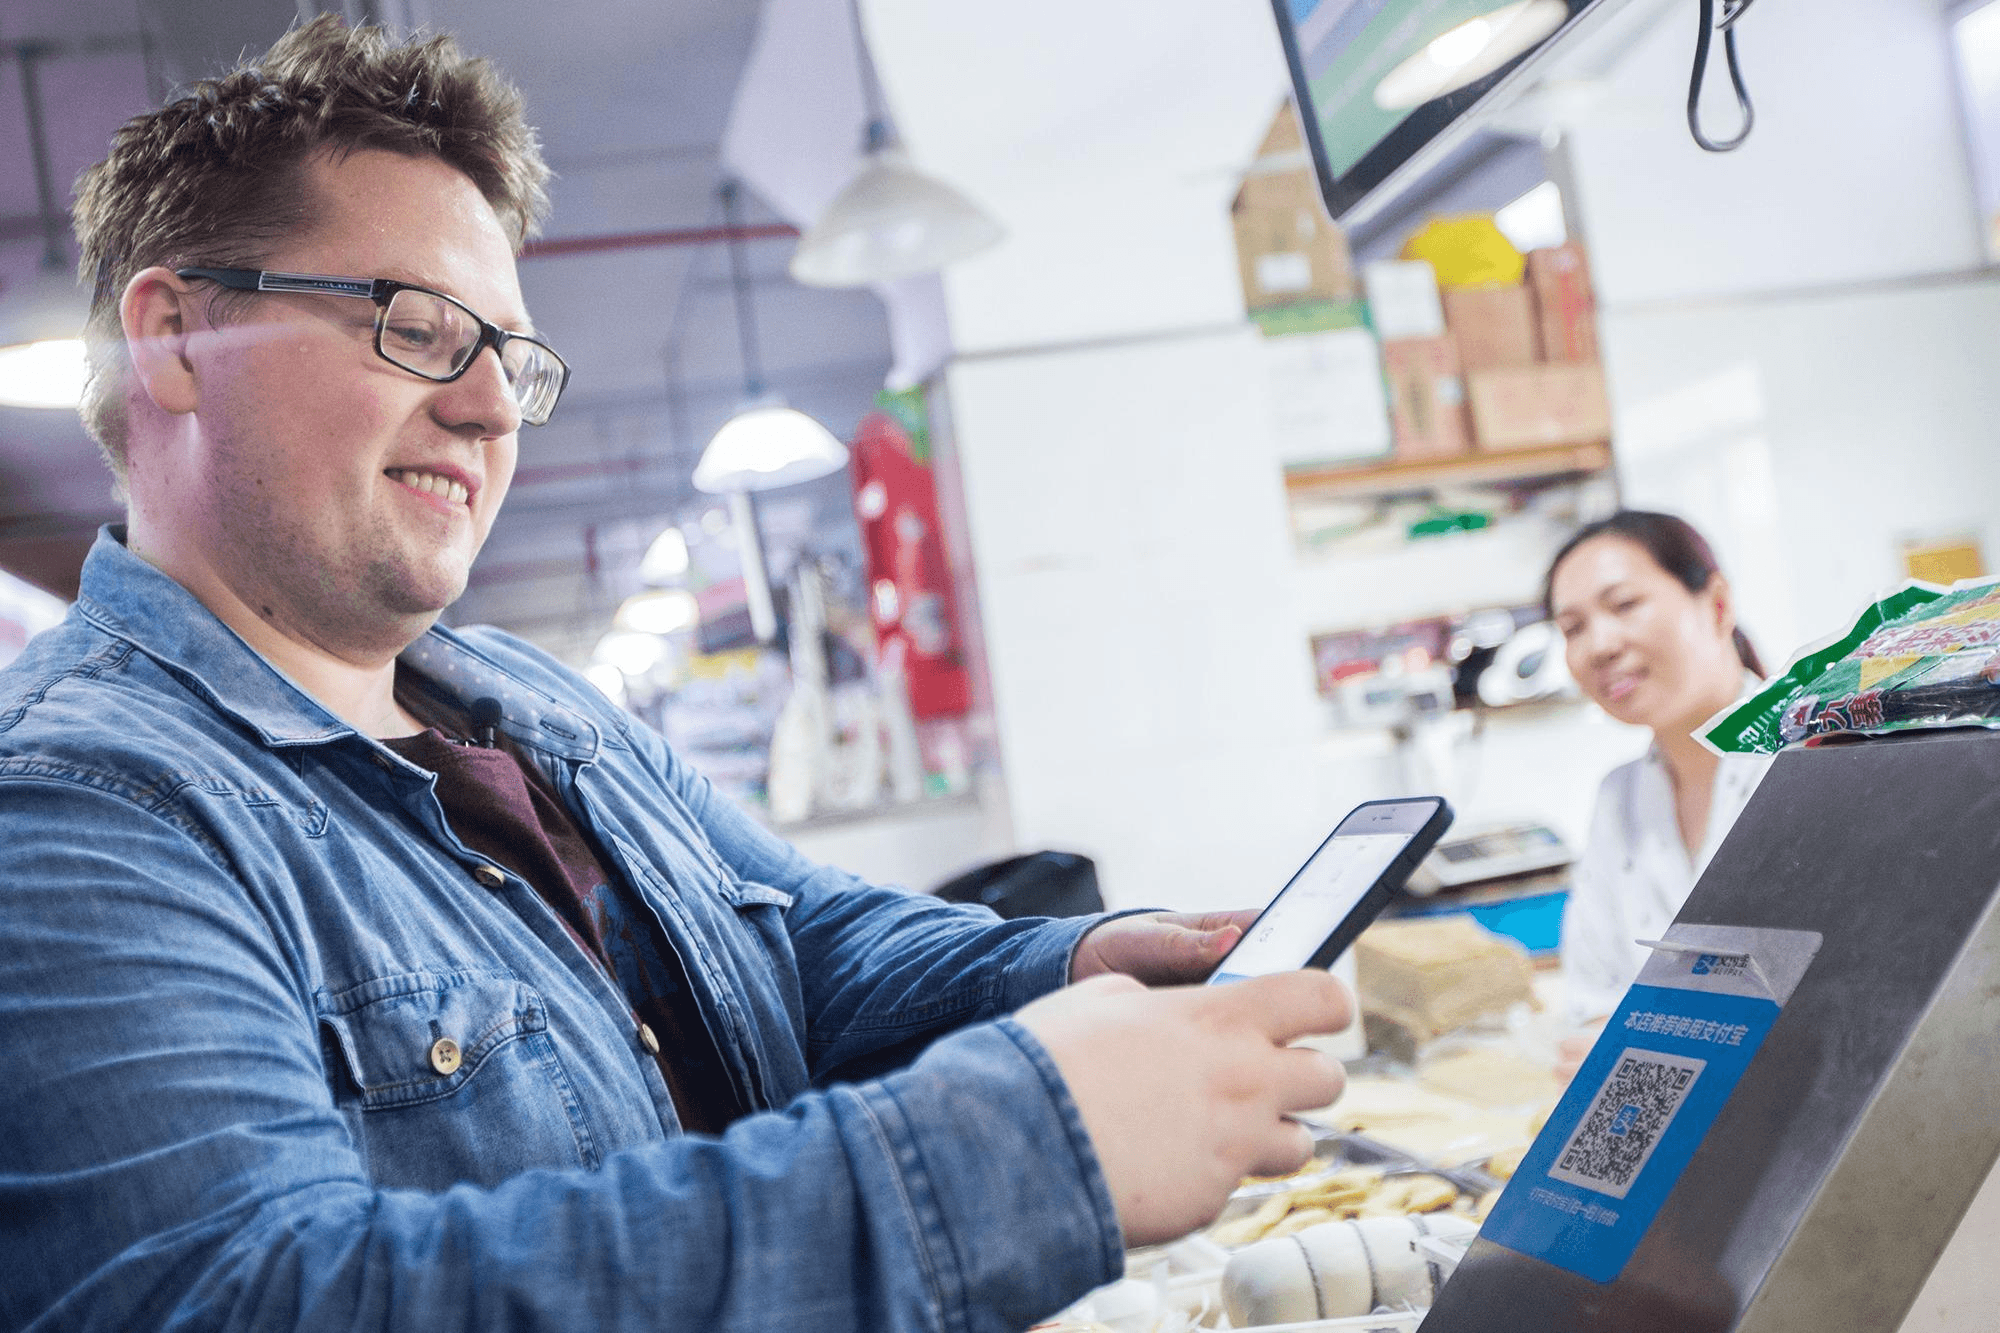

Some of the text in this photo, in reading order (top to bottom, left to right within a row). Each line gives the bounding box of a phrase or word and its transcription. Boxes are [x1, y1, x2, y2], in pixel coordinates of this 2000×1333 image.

[1624, 1010, 1749, 1046] 本店推荐使用支付宝
